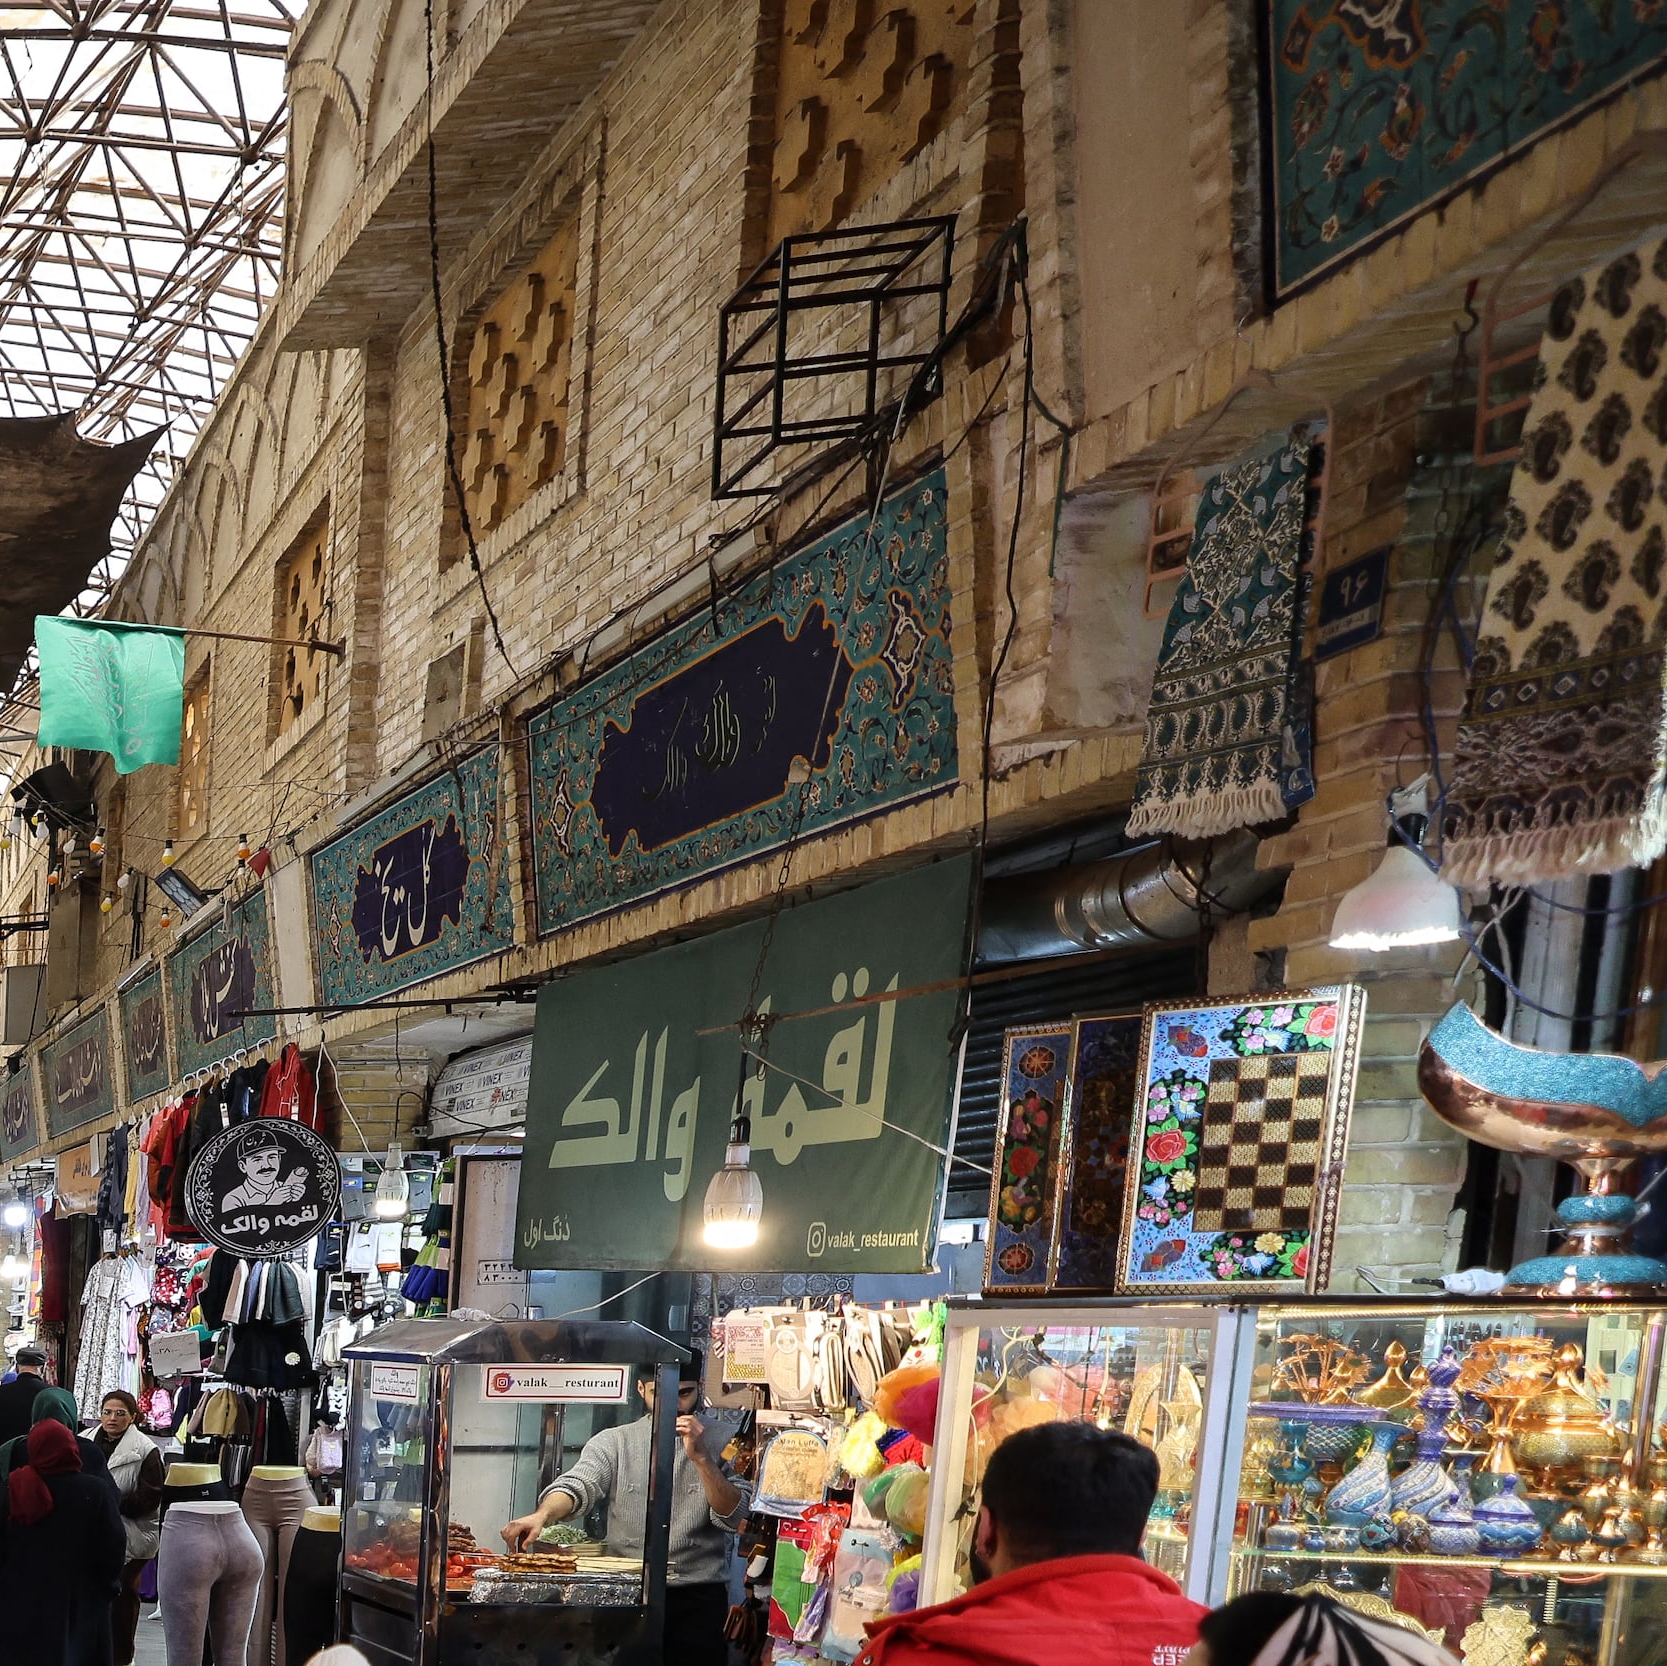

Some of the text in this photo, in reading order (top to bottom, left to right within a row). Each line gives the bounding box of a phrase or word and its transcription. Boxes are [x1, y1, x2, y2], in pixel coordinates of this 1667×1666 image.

[548, 1024, 701, 1202] والک
[220, 1204, 319, 1236] لقمه والک
[523, 1216, 543, 1248] اول
[827, 1227, 919, 1253] valak_restaurant
